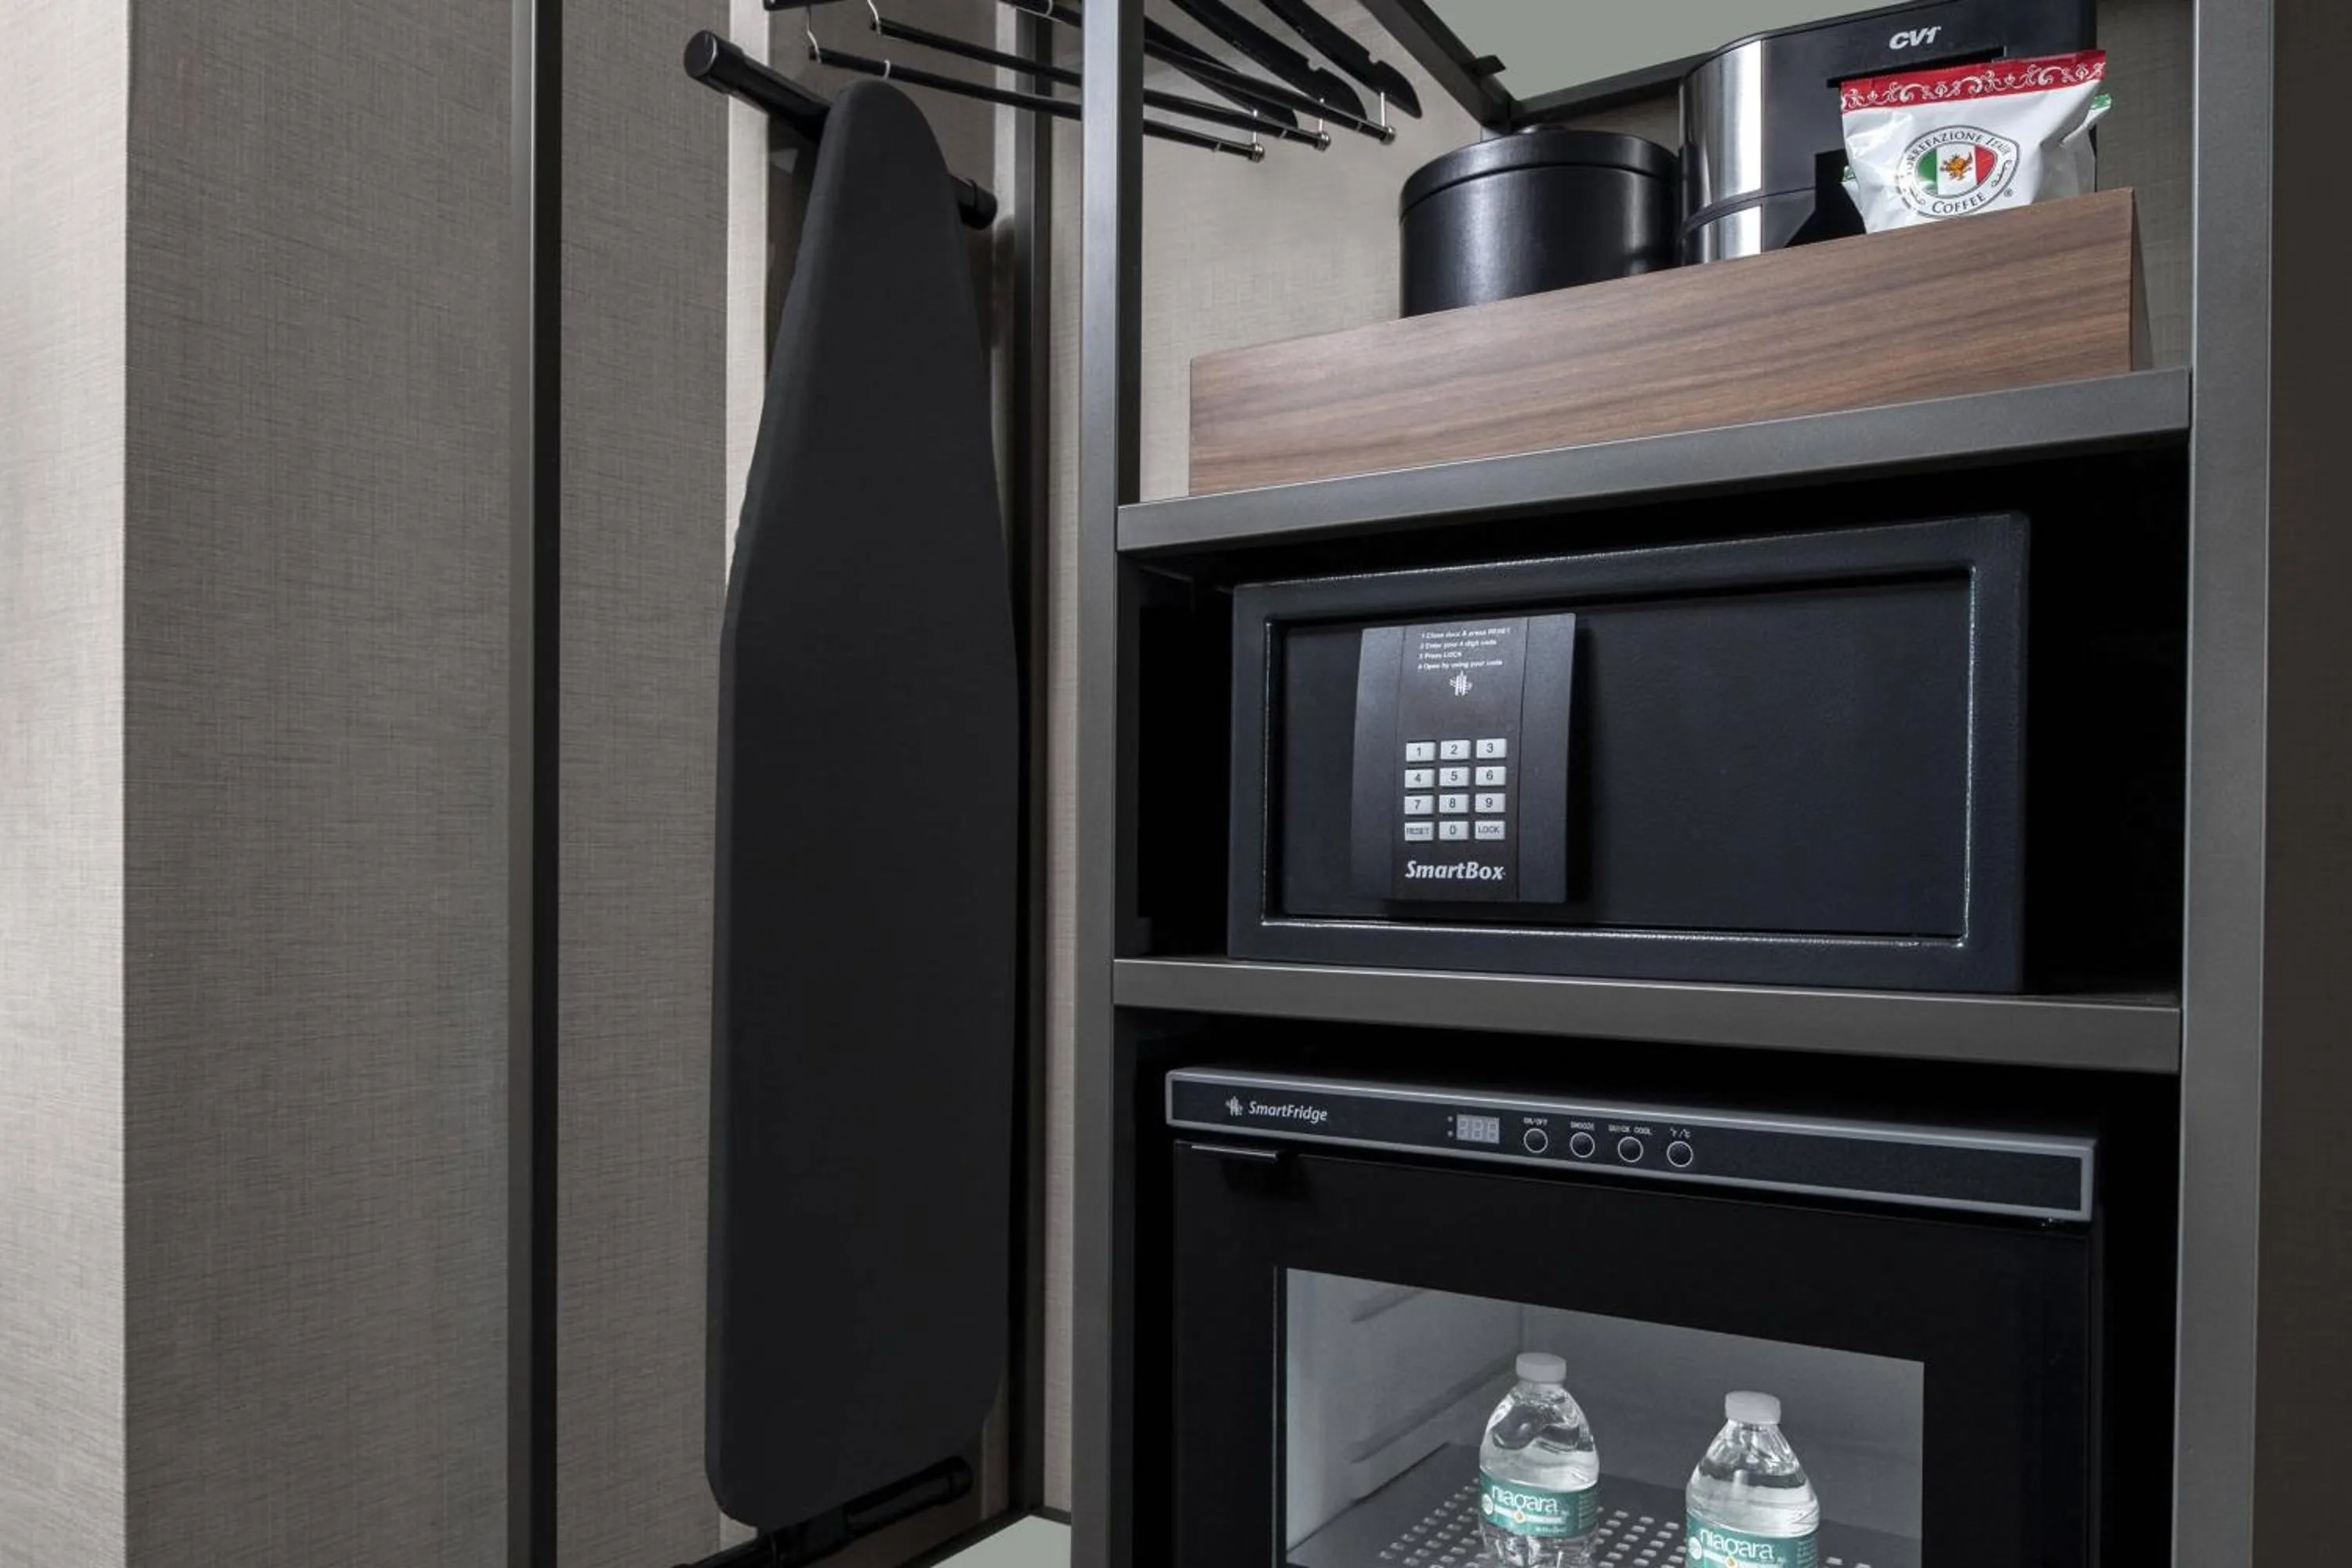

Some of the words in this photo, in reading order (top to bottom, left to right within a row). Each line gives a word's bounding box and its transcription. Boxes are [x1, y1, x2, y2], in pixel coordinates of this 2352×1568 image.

[1932, 192, 1985, 214] COFFEE
[1417, 746, 1421, 757] 1
[1450, 745, 1458, 755] 2
[1486, 742, 1494, 753] 3
[1414, 773, 1421, 782] 4
[1450, 771, 1458, 782] 5
[1486, 769, 1494, 781] 6
[1414, 799, 1421, 810] 7
[1450, 797, 1457, 808] 8
[1486, 797, 1494, 808] 9
[1406, 826, 1430, 836] RESET
[1450, 825, 1457, 836] 0
[1478, 826, 1501, 834] LOCK
[1404, 860, 1504, 880] SmartBox
[1248, 1101, 1328, 1124] SmartFridge
[1491, 1485, 1559, 1513] niagara
[1699, 1528, 1775, 1560] niagara
